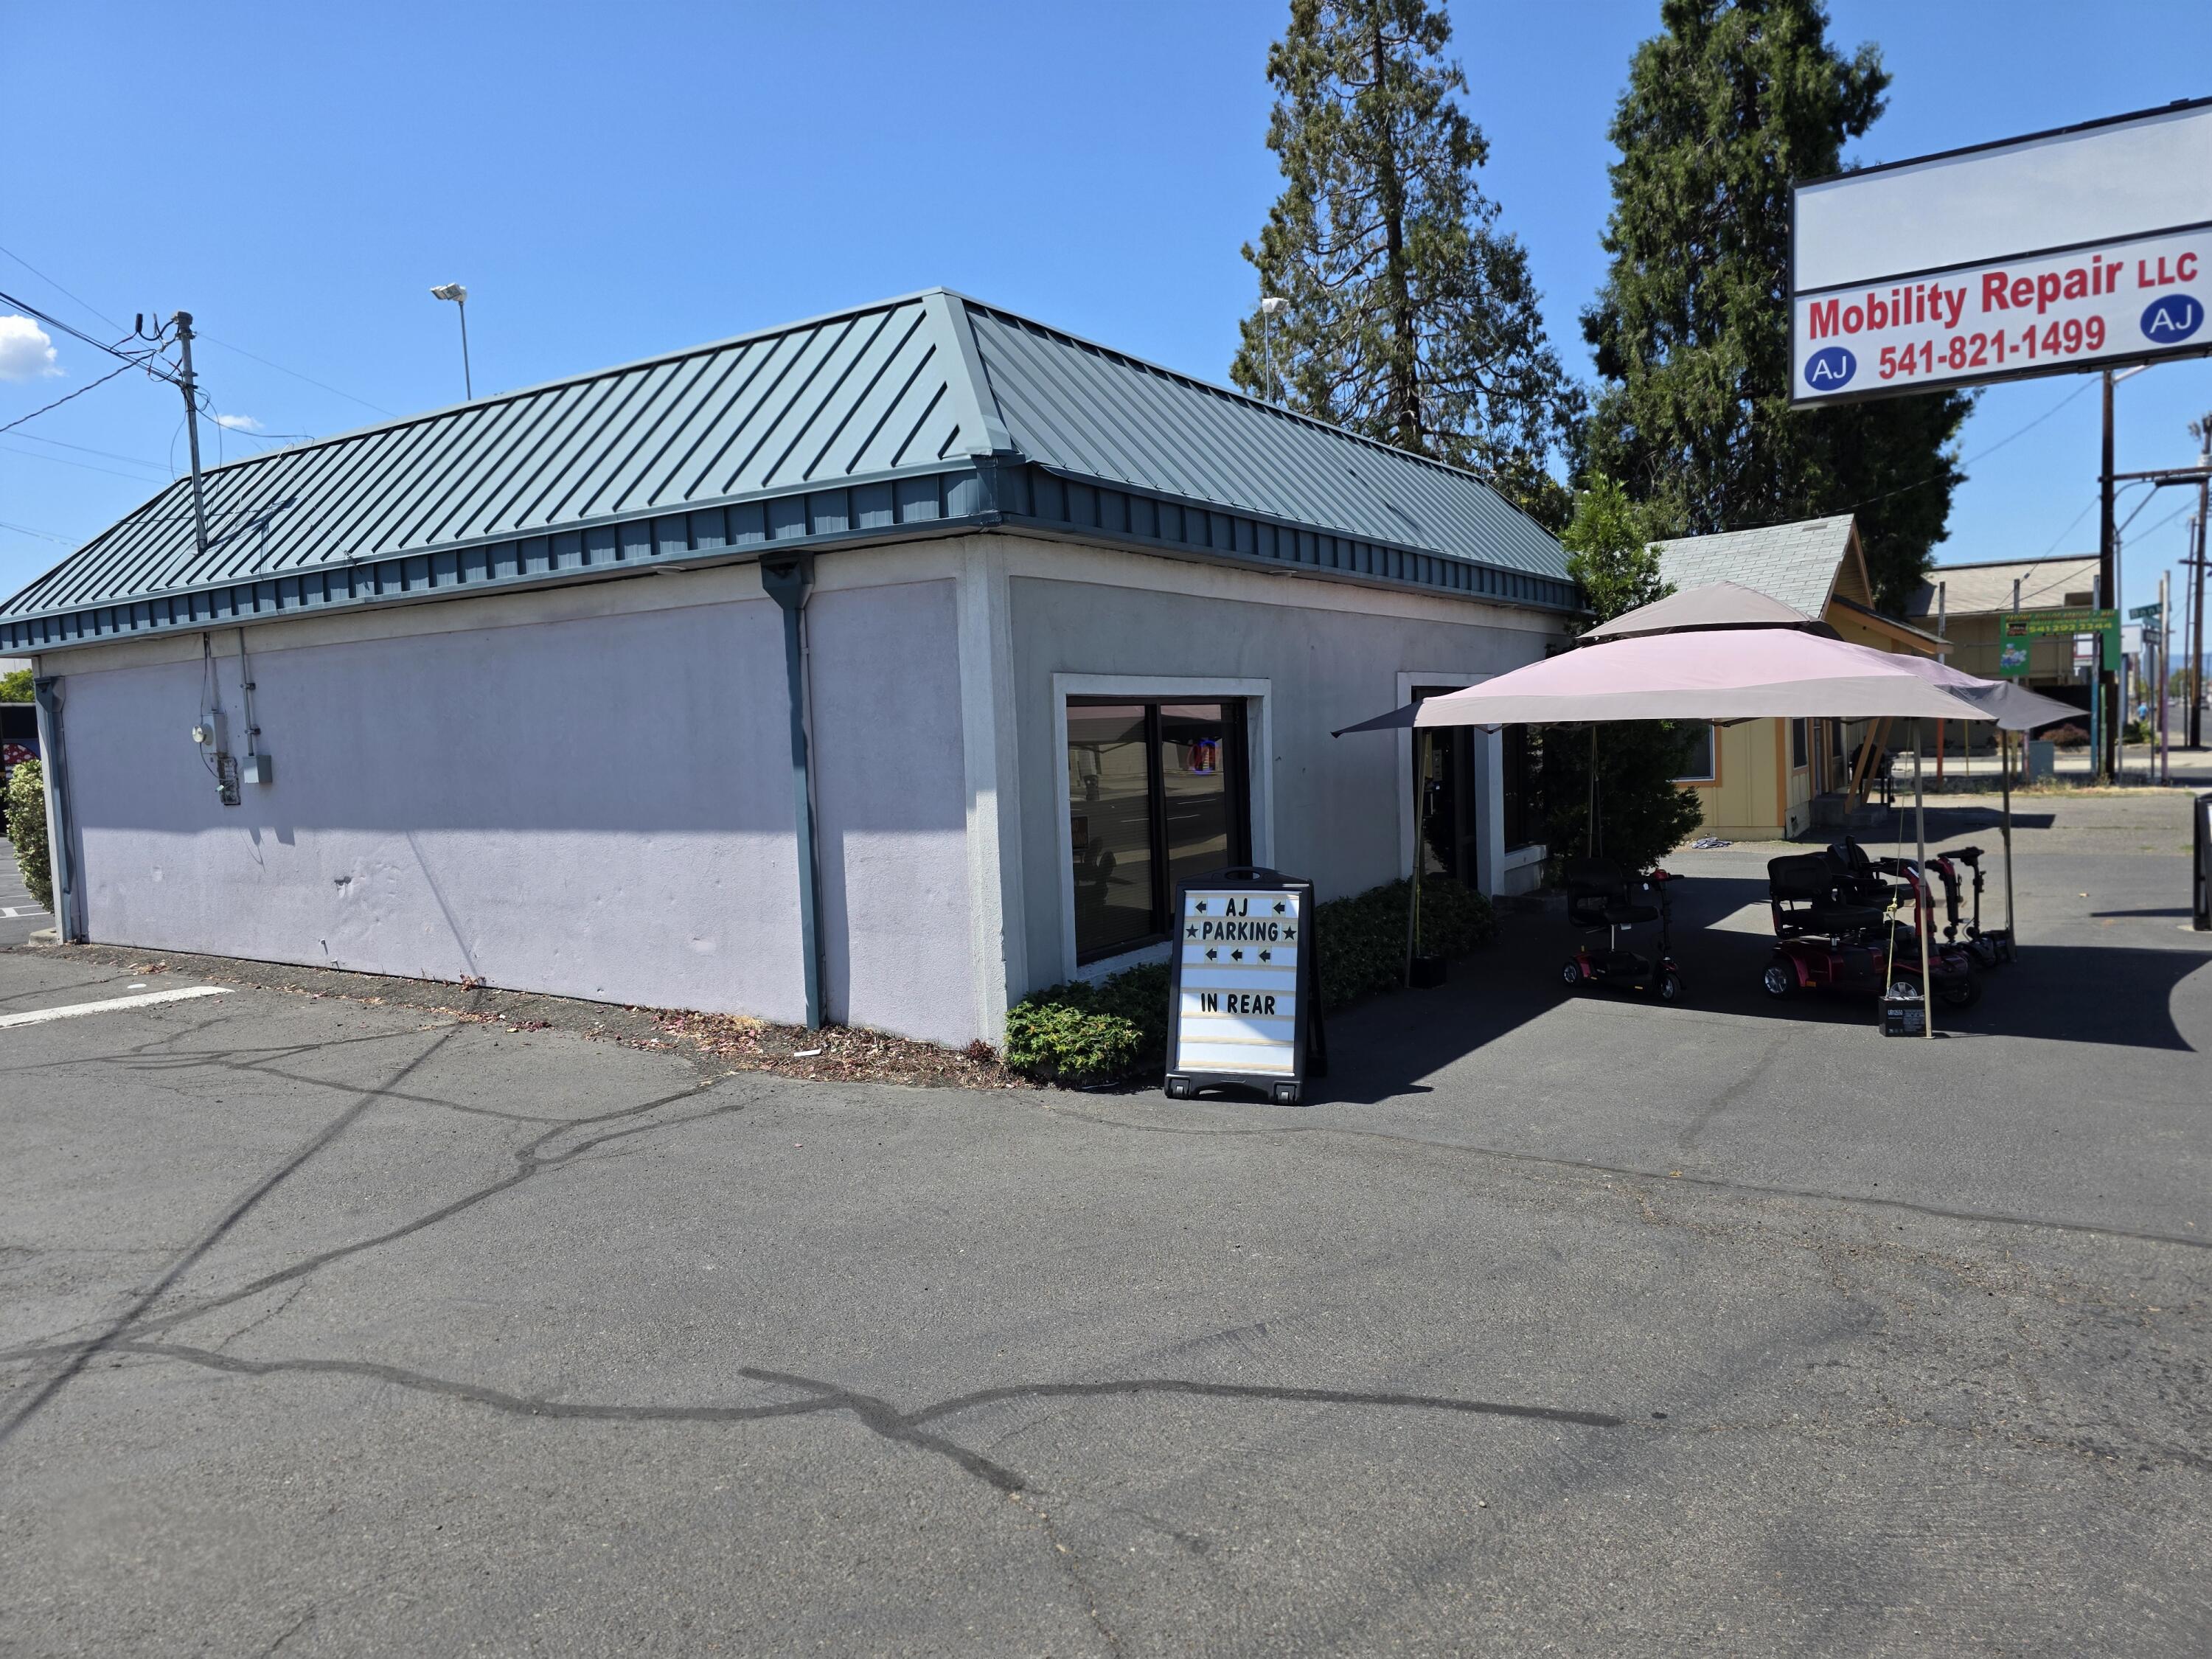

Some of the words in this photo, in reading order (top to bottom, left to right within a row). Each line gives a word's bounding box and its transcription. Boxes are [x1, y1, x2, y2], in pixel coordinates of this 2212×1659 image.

[1810, 282, 1967, 340] Mobility
[1982, 254, 2124, 315] Repair
[2138, 251, 2198, 288] LLC
[2149, 304, 2192, 334] AJ
[1878, 315, 2106, 380] 541-821-1499
[1812, 355, 1847, 383] AJ
[1225, 897, 1248, 917] AJ
[1203, 922, 1279, 942] PARKING
[1200, 992, 1217, 1013] IN
[1227, 994, 1276, 1015] REAR
